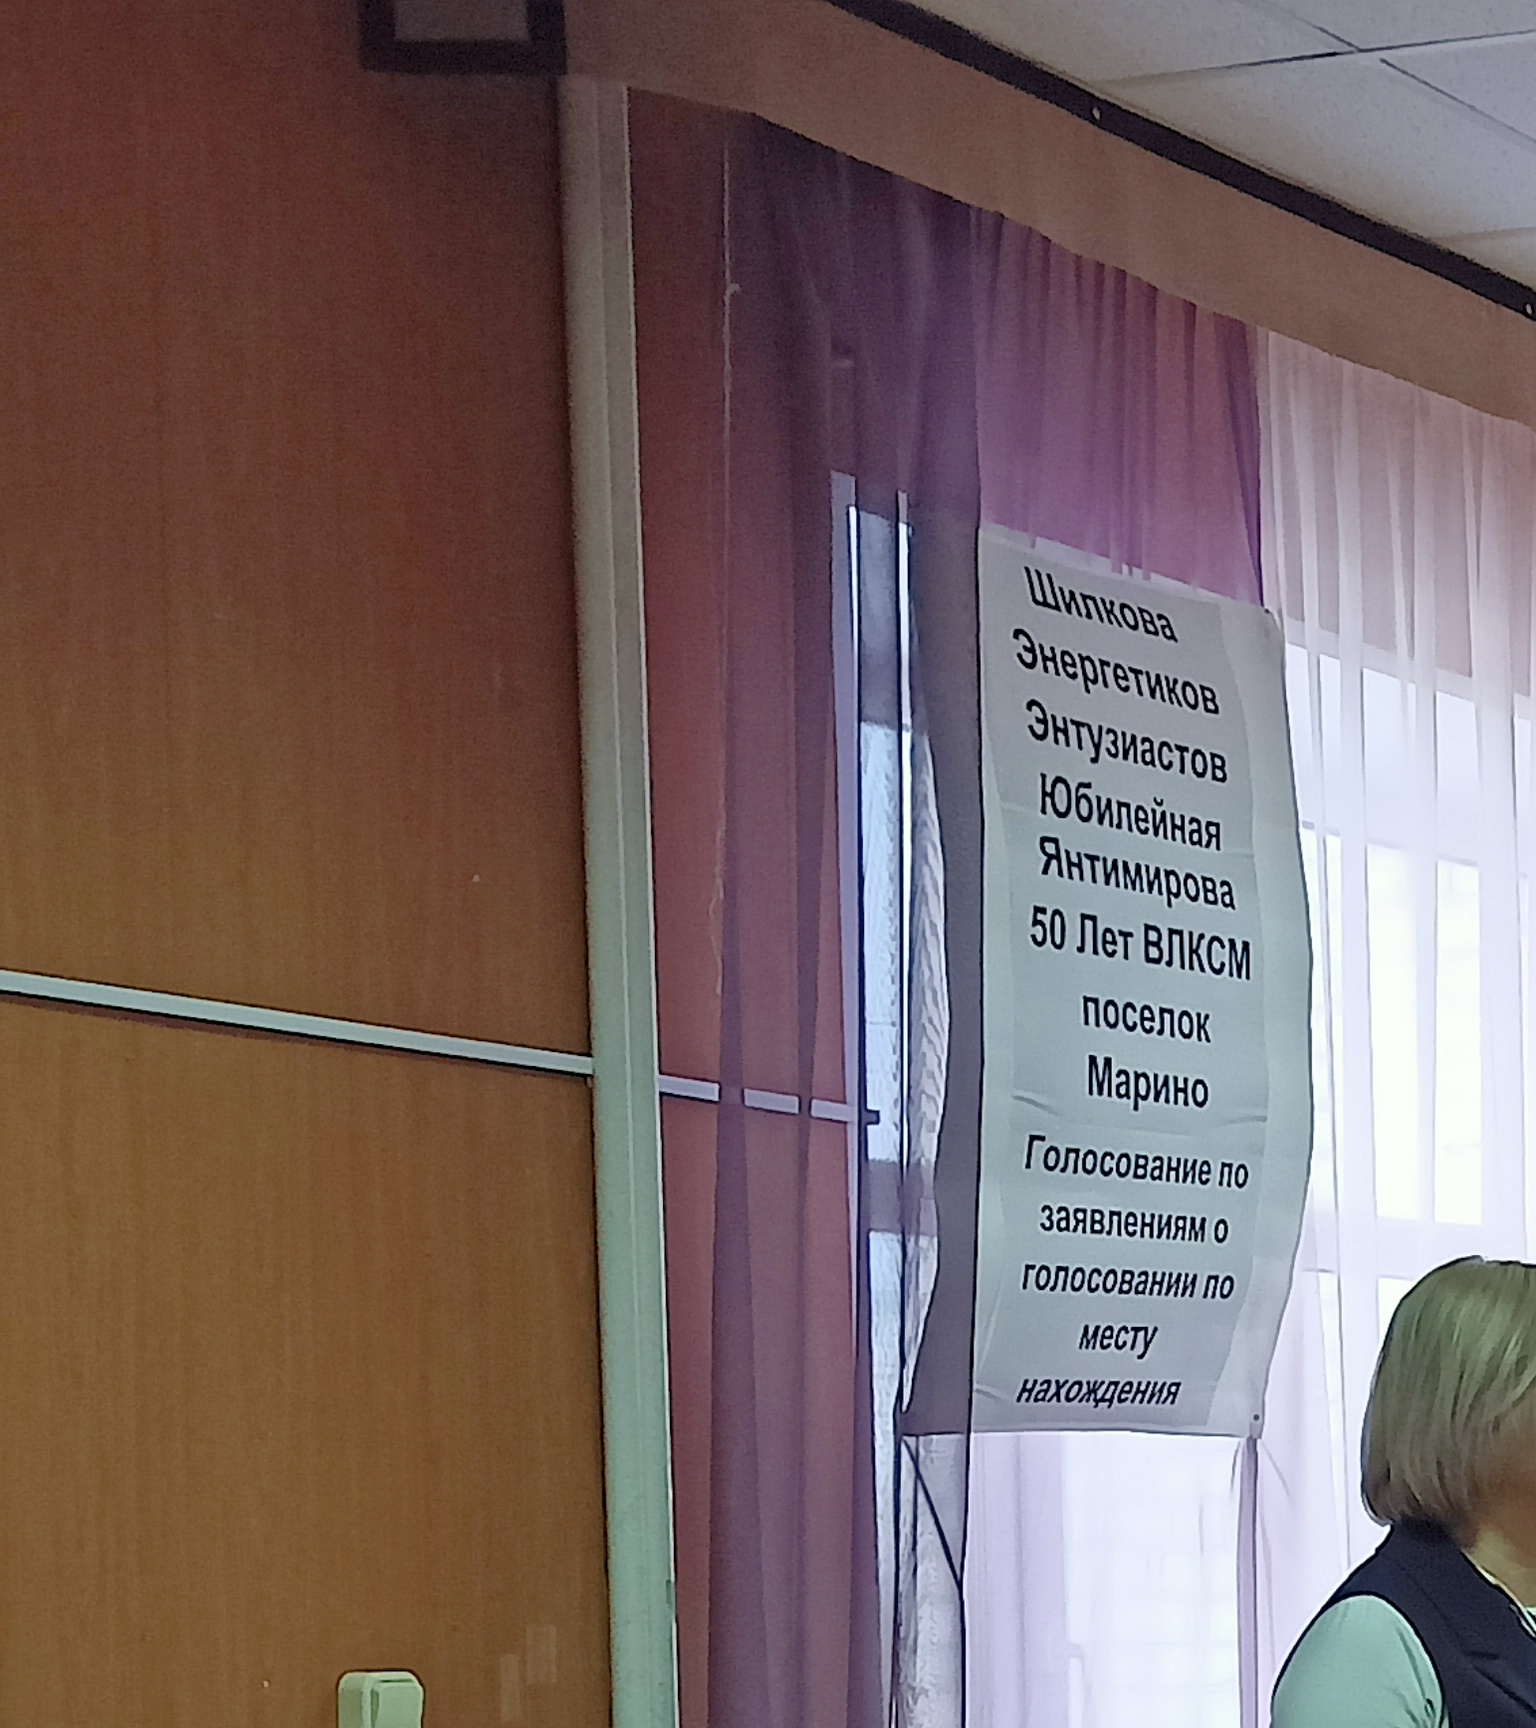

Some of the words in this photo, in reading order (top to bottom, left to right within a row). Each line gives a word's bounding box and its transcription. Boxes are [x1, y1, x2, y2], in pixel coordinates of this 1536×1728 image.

[1024, 566, 1178, 643] Шилкова
[1012, 628, 1220, 715] Энергетиков
[1026, 699, 1228, 783] Энтузиастов
[1039, 773, 1222, 851] Юбилейная
[1039, 836, 1236, 910] Янтимирова
[1030, 905, 1066, 951] 50
[1076, 914, 1134, 961] Лет
[1143, 924, 1251, 981] ВЛКСМ
[1082, 995, 1212, 1044] поселок
[1087, 1054, 1209, 1111] Марино
[1025, 1134, 1211, 1185] Голосование
[1218, 1161, 1248, 1189] по
[1039, 1204, 1206, 1243] заявлениям
[1213, 1217, 1229, 1243] о
[1021, 1262, 1197, 1298] голосовании
[1203, 1273, 1235, 1300] по
[1078, 1324, 1158, 1360] месту
[1015, 1378, 1181, 1409] нахождения
